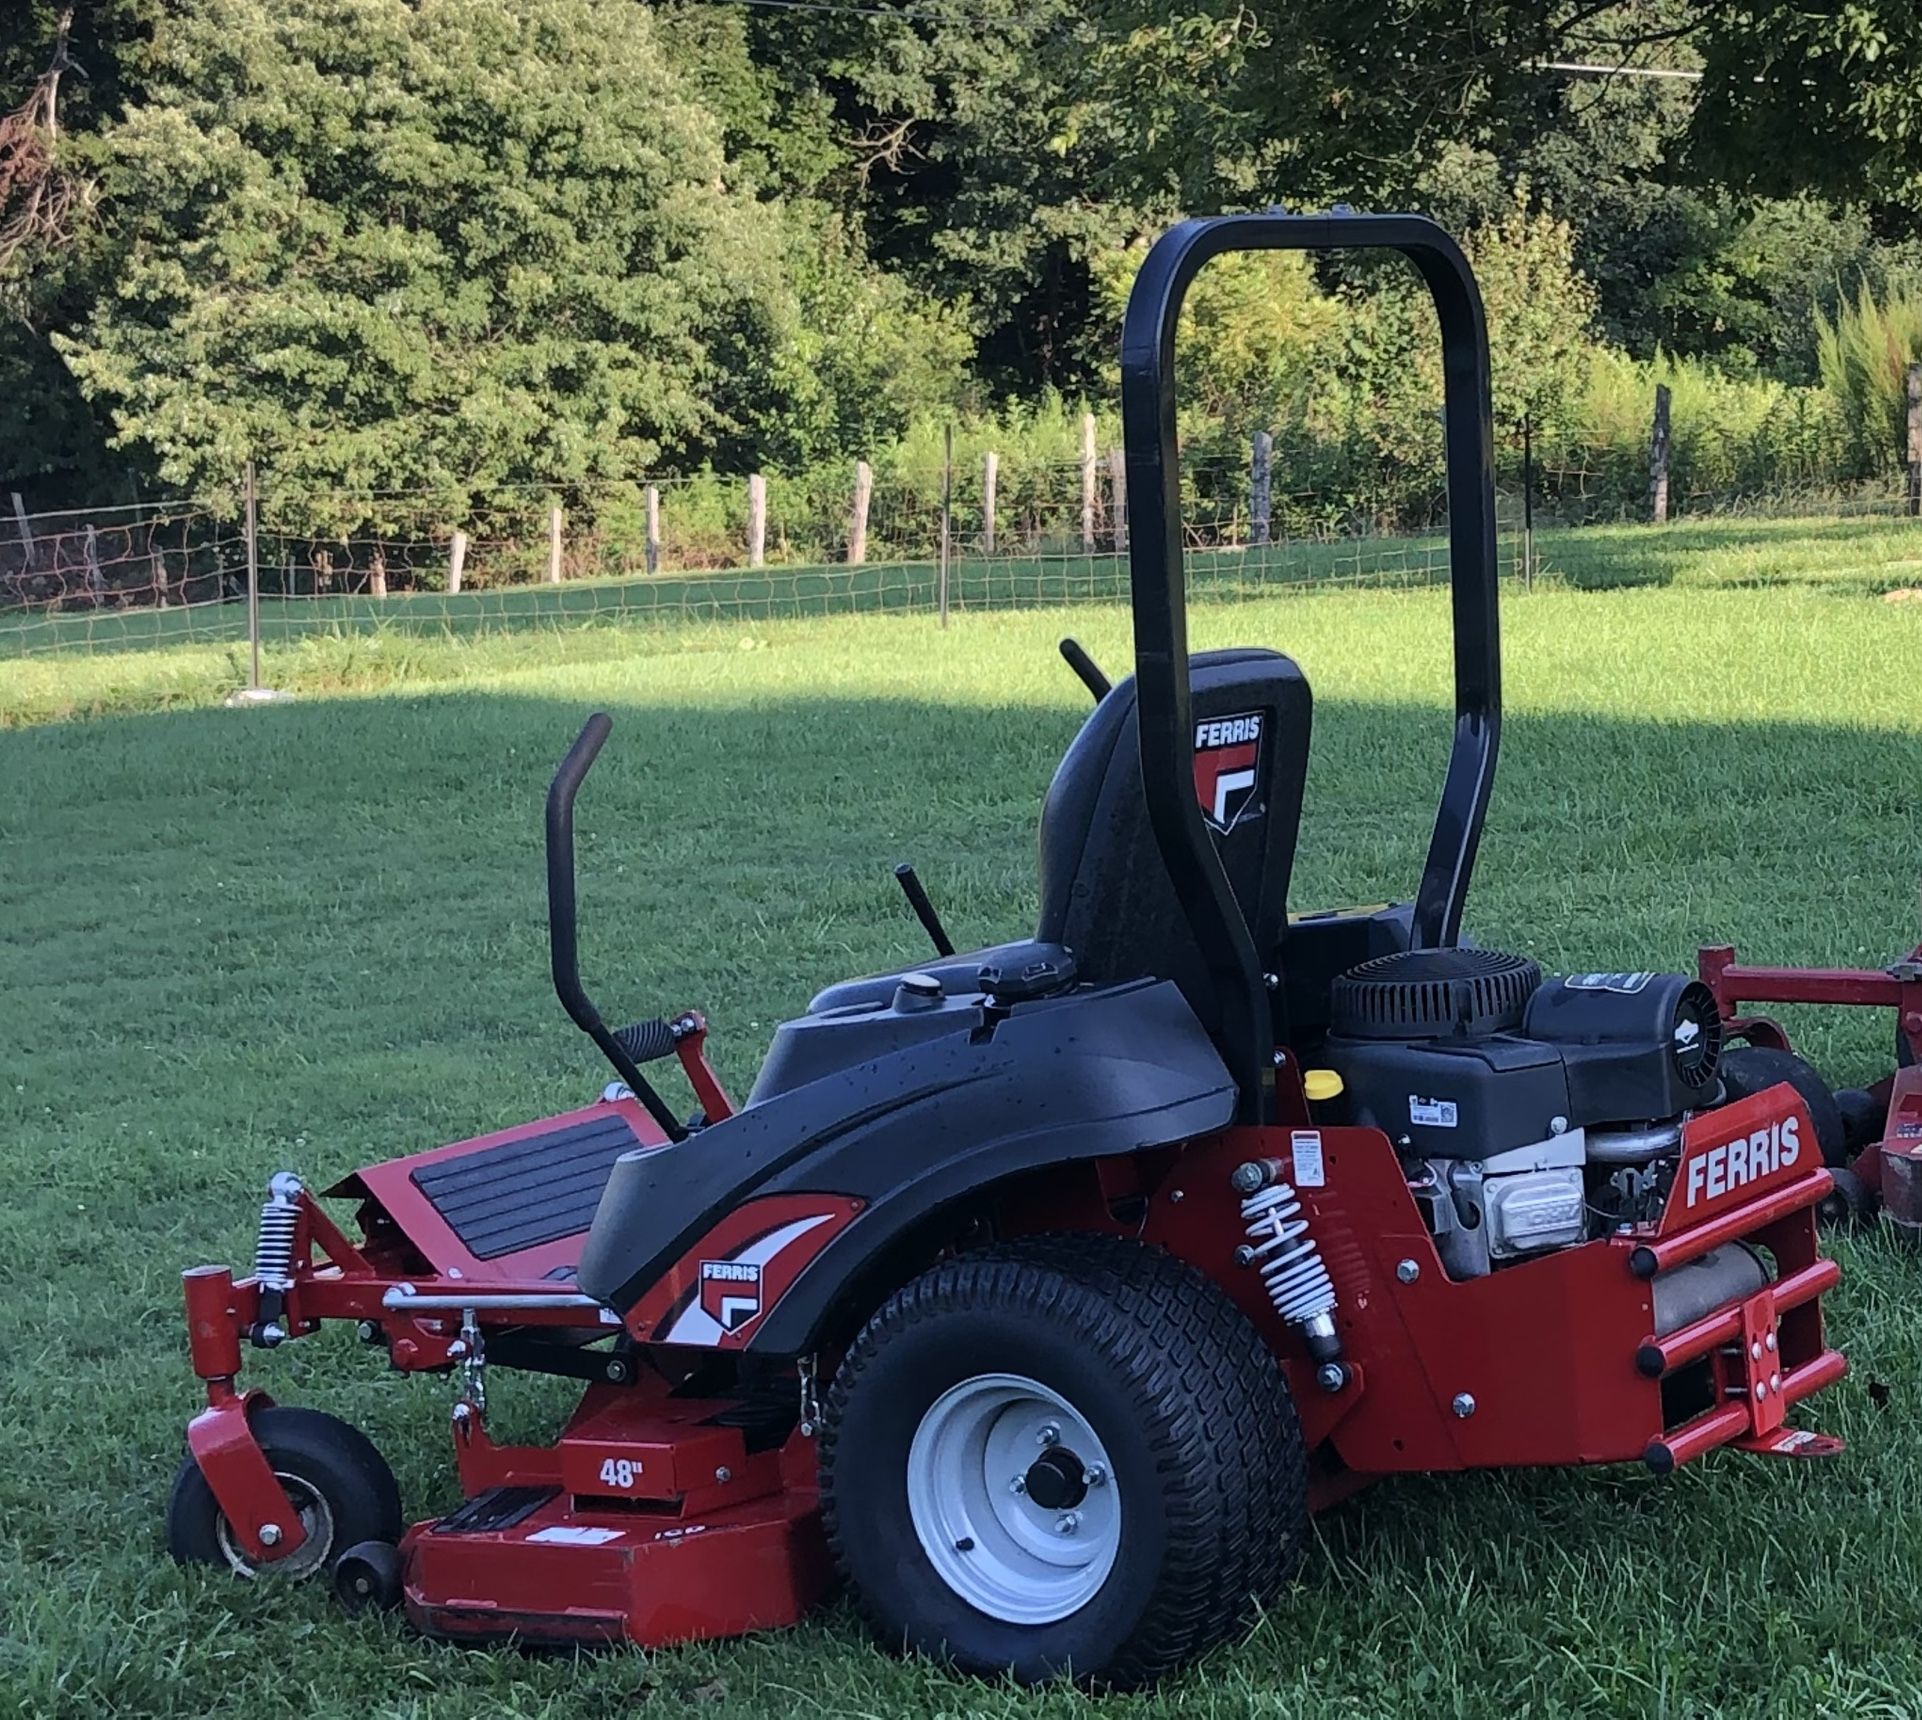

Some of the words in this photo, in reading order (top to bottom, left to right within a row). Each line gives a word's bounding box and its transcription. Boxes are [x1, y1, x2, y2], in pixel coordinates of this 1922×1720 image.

[1195, 716, 1260, 748] FERRIS
[1686, 1116, 1800, 1208] FERRIS
[702, 1263, 759, 1282] FERRIS
[599, 1458, 643, 1488] 48"
